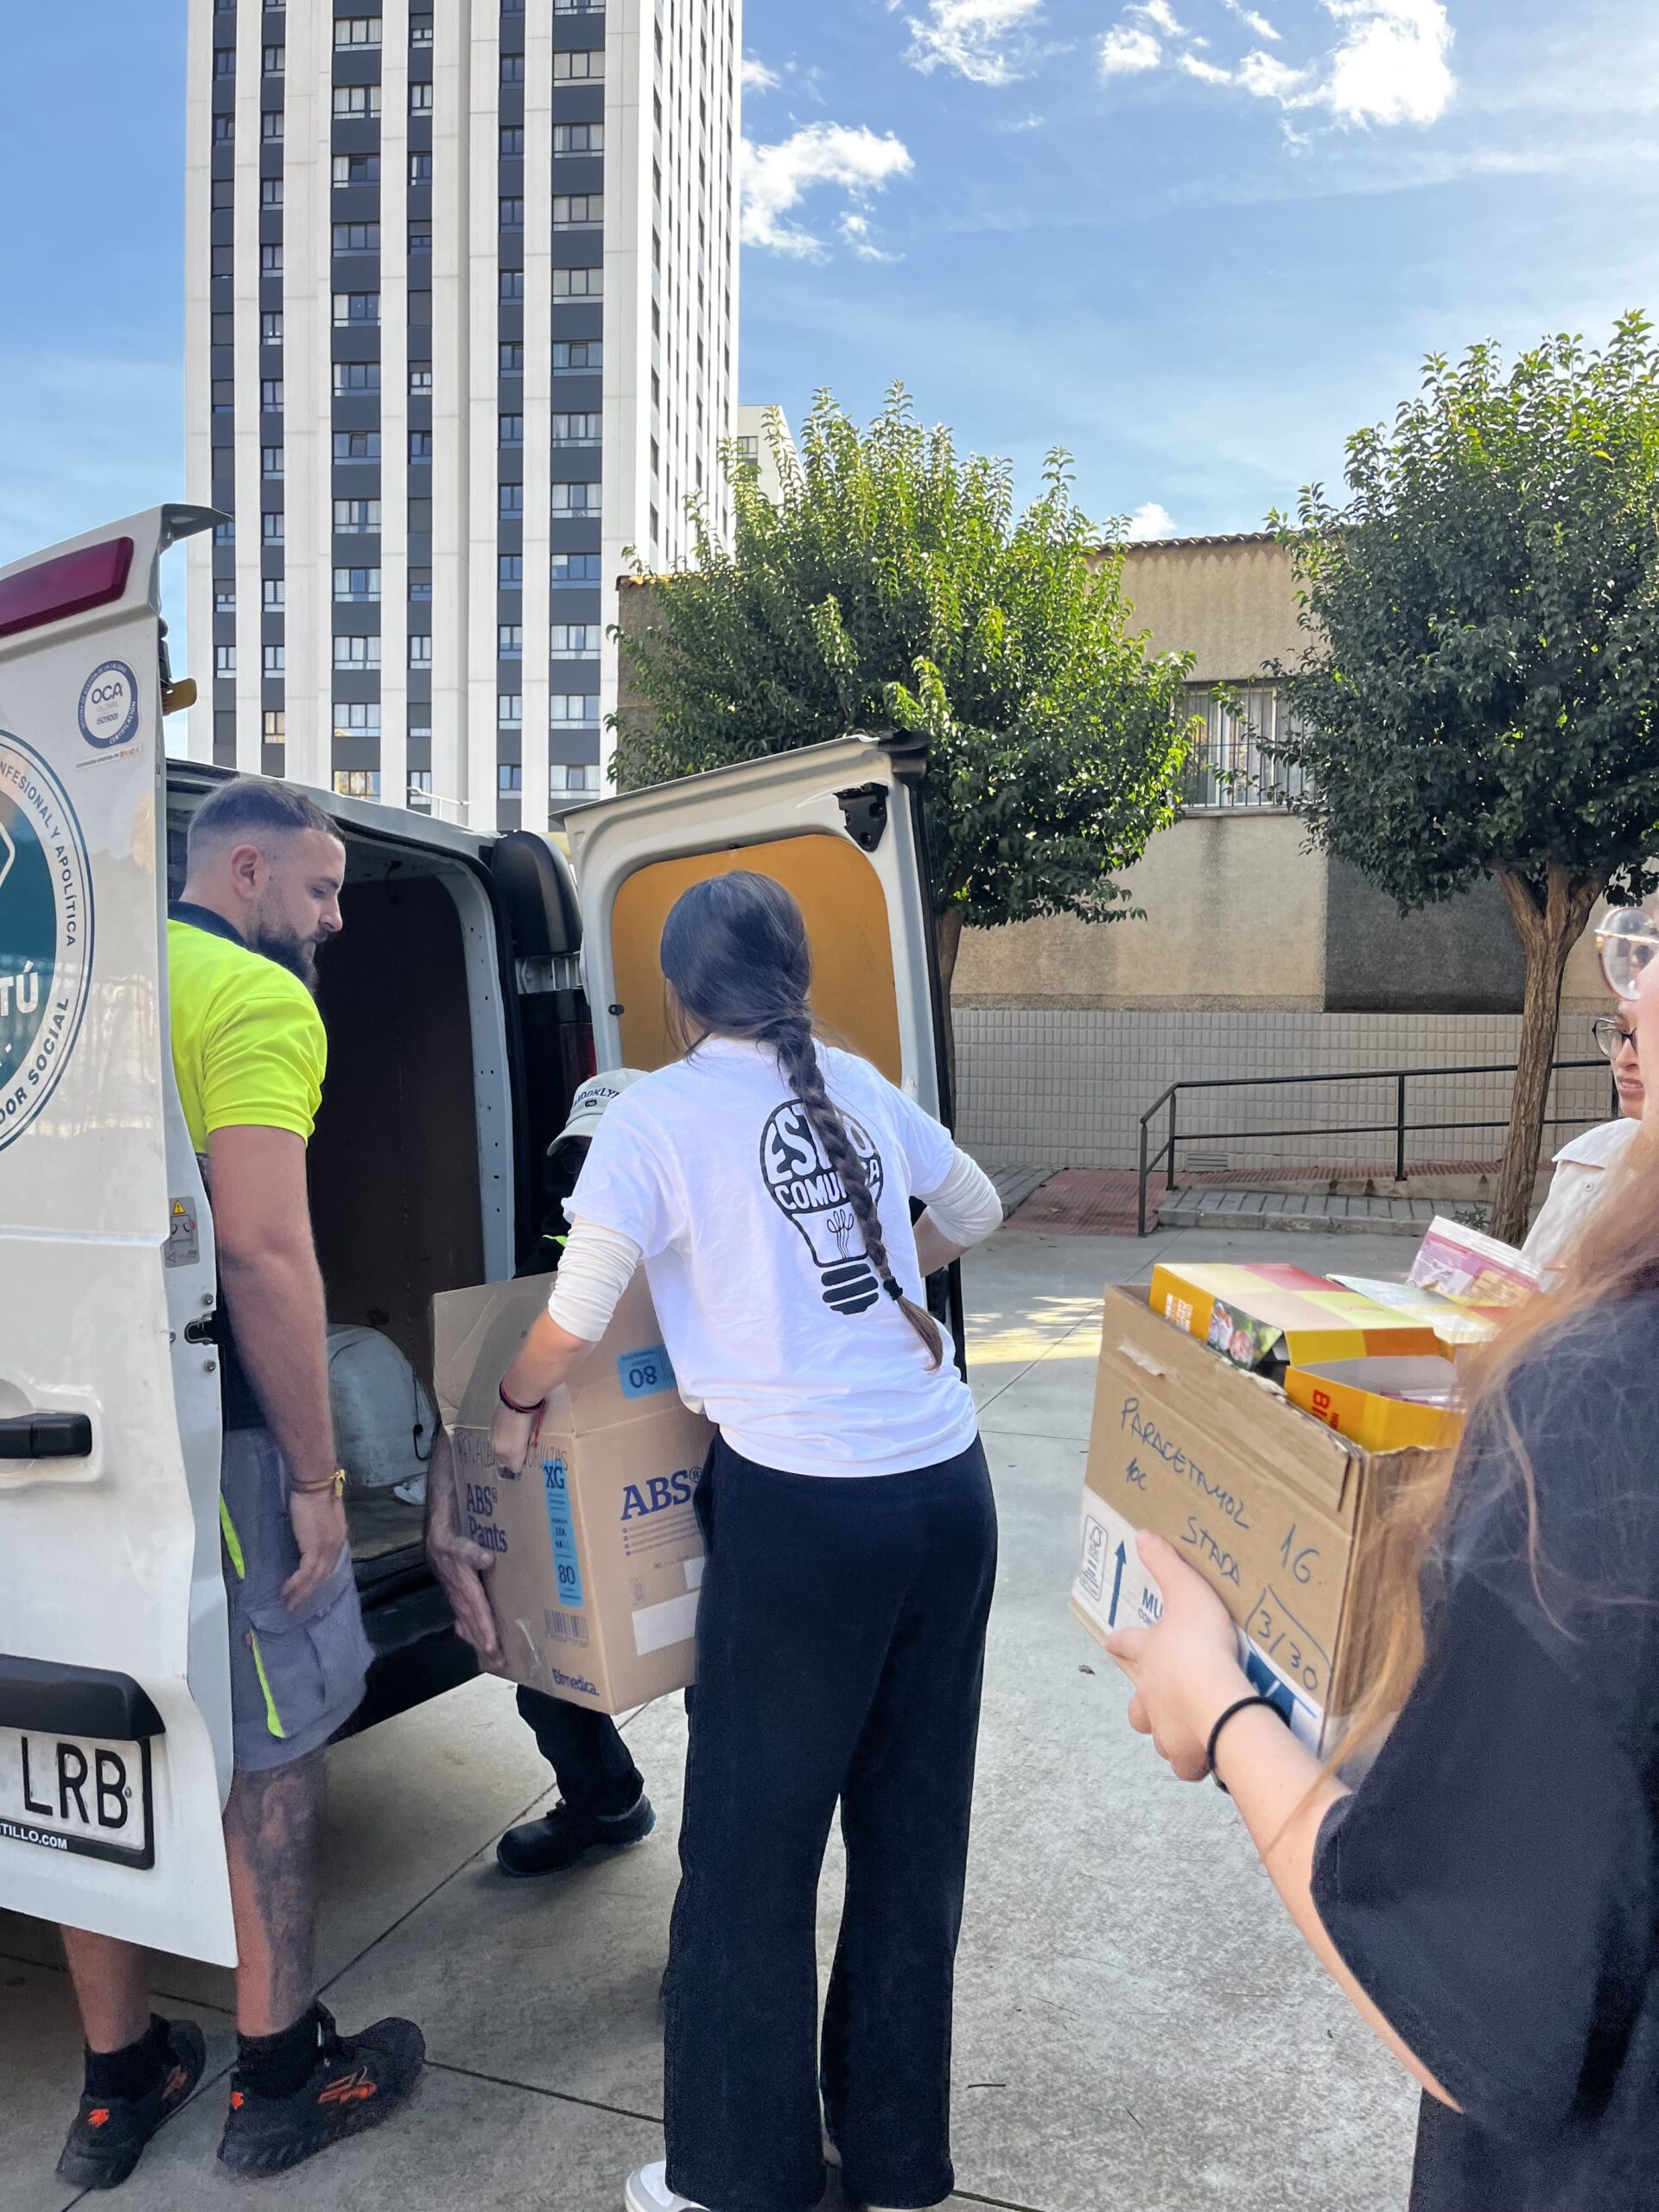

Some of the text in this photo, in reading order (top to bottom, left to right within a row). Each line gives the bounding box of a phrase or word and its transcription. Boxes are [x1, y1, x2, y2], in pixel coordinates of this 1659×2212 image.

[92, 683, 123, 704] OCA
[50, 826, 61, 840] Y
[55, 845, 78, 947] APOLÍTICA
[28, 998, 68, 1085] SOCIAL
[543, 1466, 565, 1490] XG
[1121, 1397, 1250, 1530] PARACETAMOL
[468, 1516, 508, 1553] Pants
[1180, 1516, 1240, 1587] STADA
[558, 1564, 576, 1586] 80
[21, 1736, 129, 1829] LRB
[0, 1822, 68, 1850] TILLO.COM
